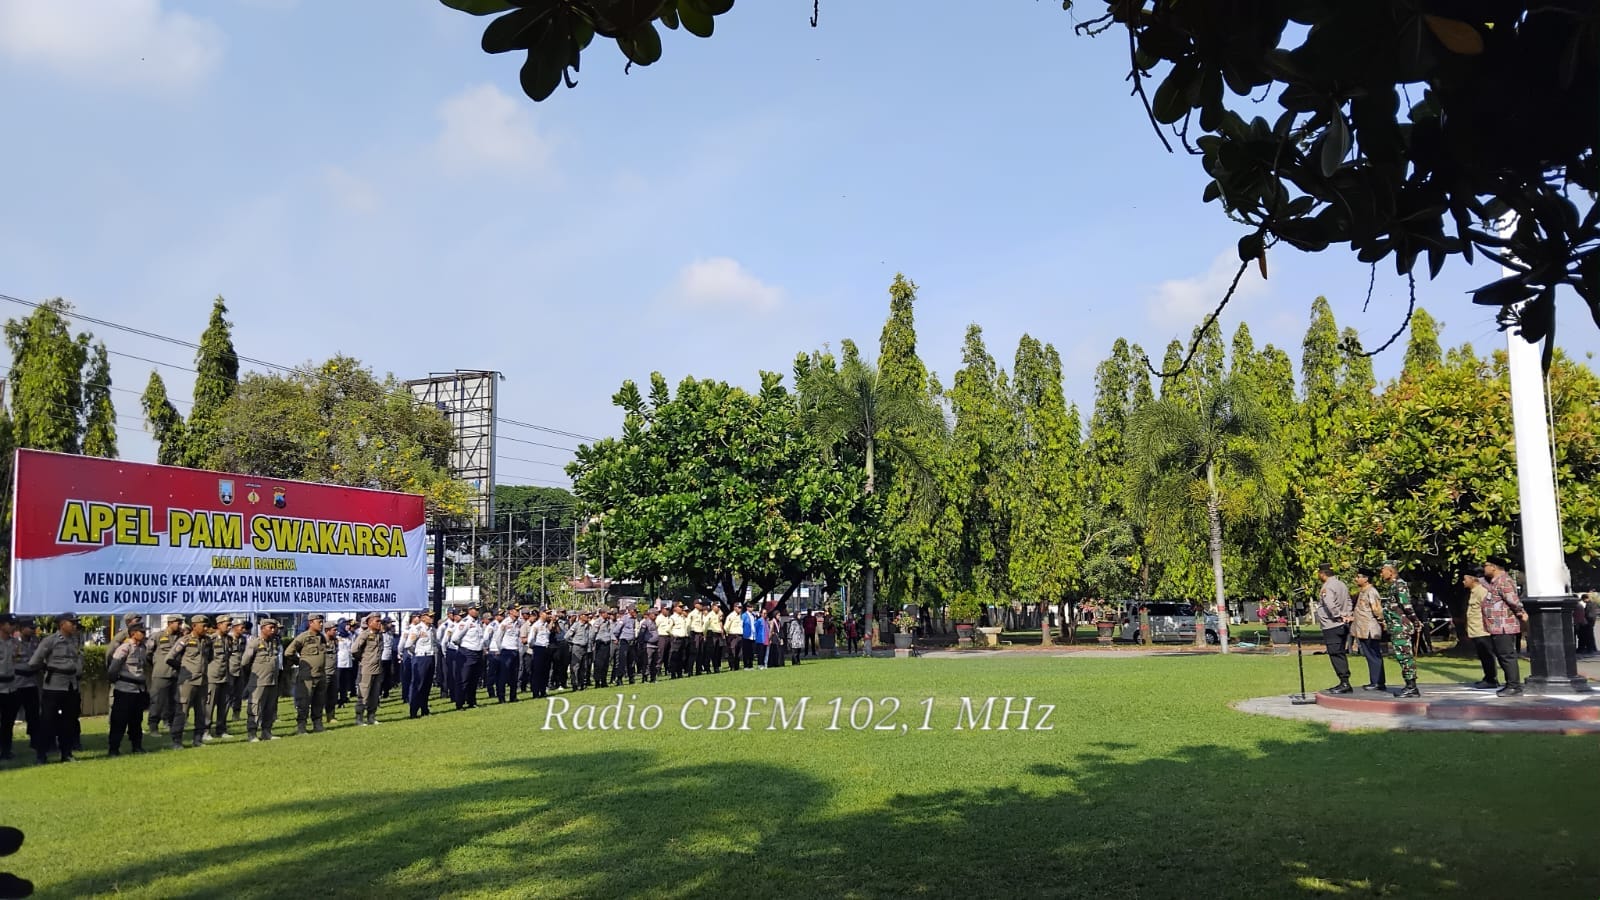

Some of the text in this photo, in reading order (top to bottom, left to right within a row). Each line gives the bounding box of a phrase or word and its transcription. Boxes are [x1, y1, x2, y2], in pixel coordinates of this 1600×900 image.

[57, 500, 408, 558] APEL PAM SWAKARSA
[211, 555, 297, 571] DALAM RANGKA
[84, 572, 390, 589] MENDUKUNG KEAMANAN DAN KETERTIBAN MASYARAKAT
[73, 590, 397, 604] YANG KONDUSIF DI WILAYAH HUKUM KABUPATEN REMBANG
